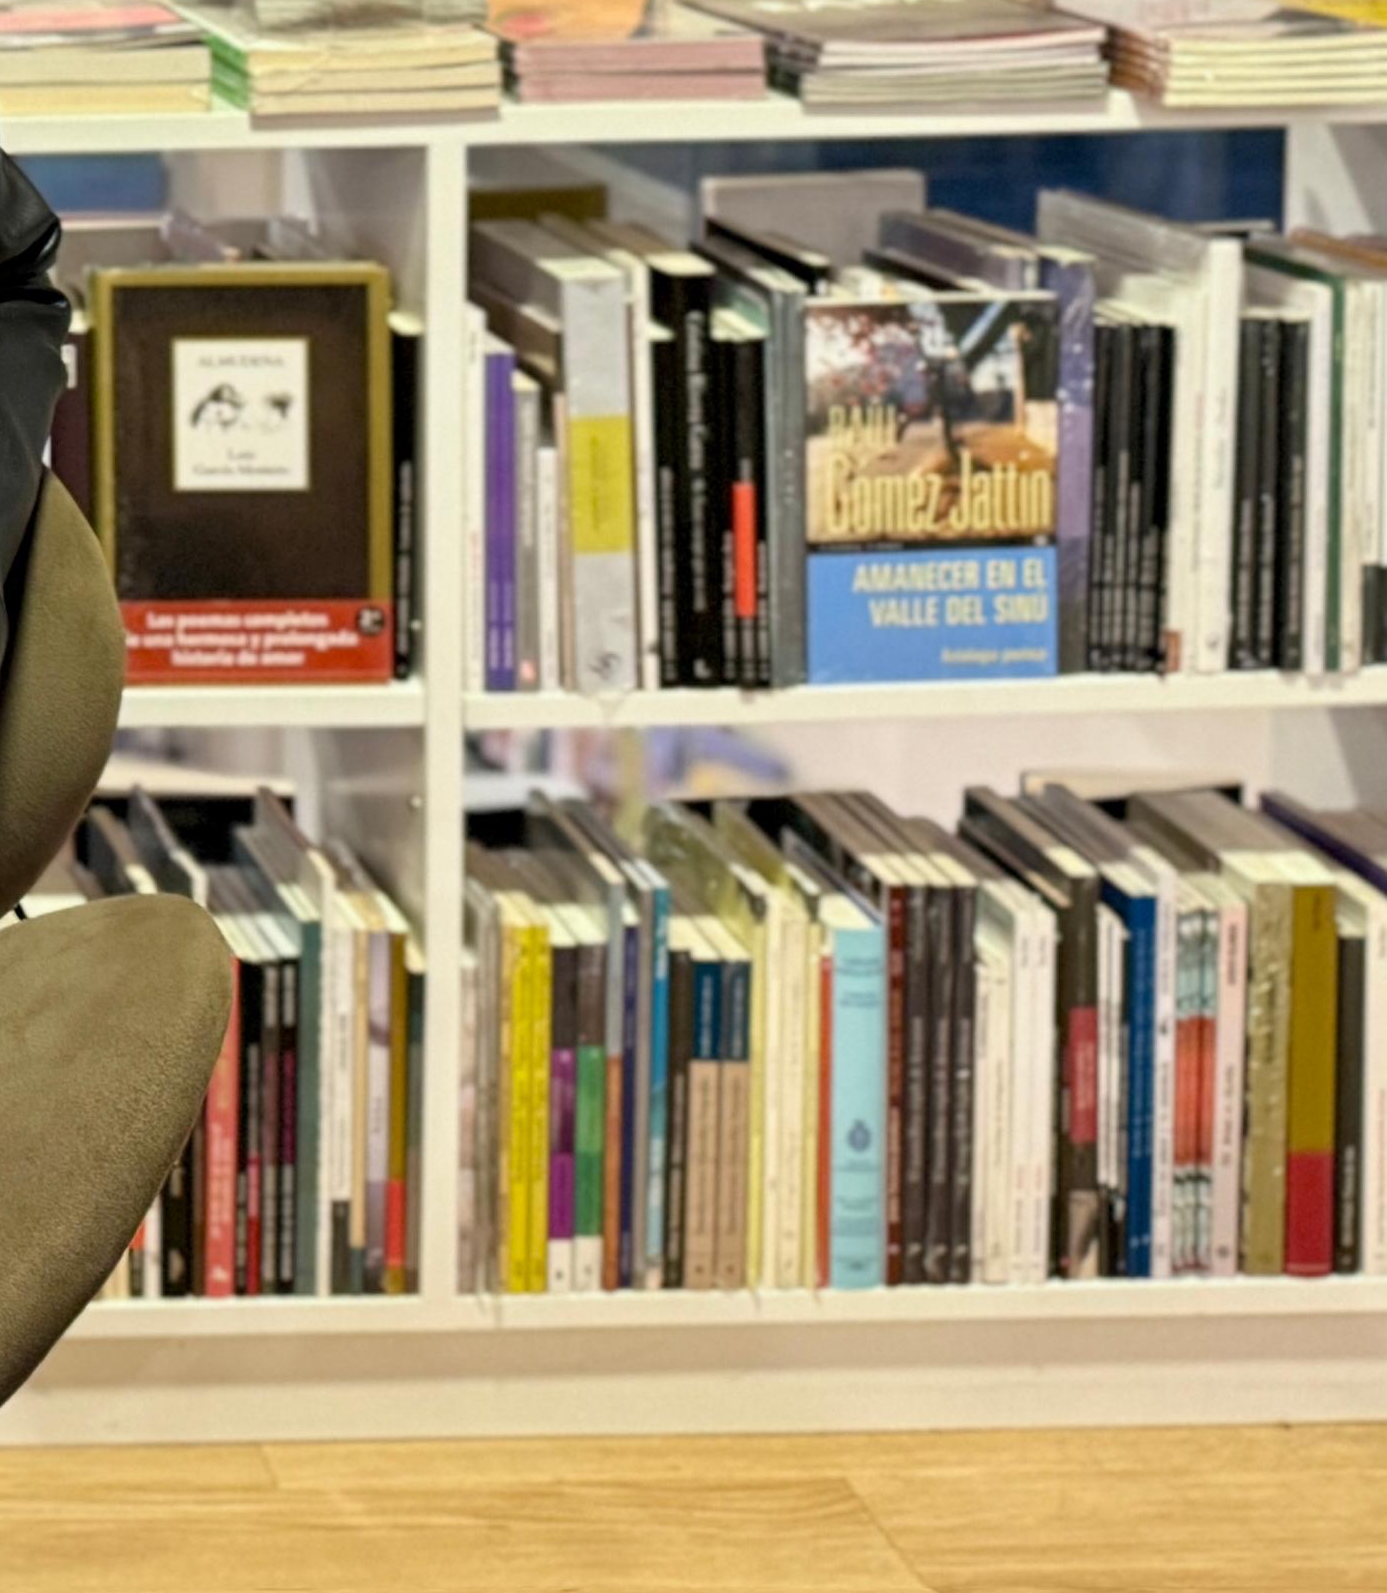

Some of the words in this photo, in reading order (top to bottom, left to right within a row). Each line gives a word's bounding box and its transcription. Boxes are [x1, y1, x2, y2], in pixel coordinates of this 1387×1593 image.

[947, 447, 1052, 532] Jattin
[853, 561, 979, 593] AMANECER
[986, 559, 1016, 589] EN
[1023, 557, 1047, 588] EL
[868, 596, 938, 627] VALLE
[945, 595, 985, 625] DEL
